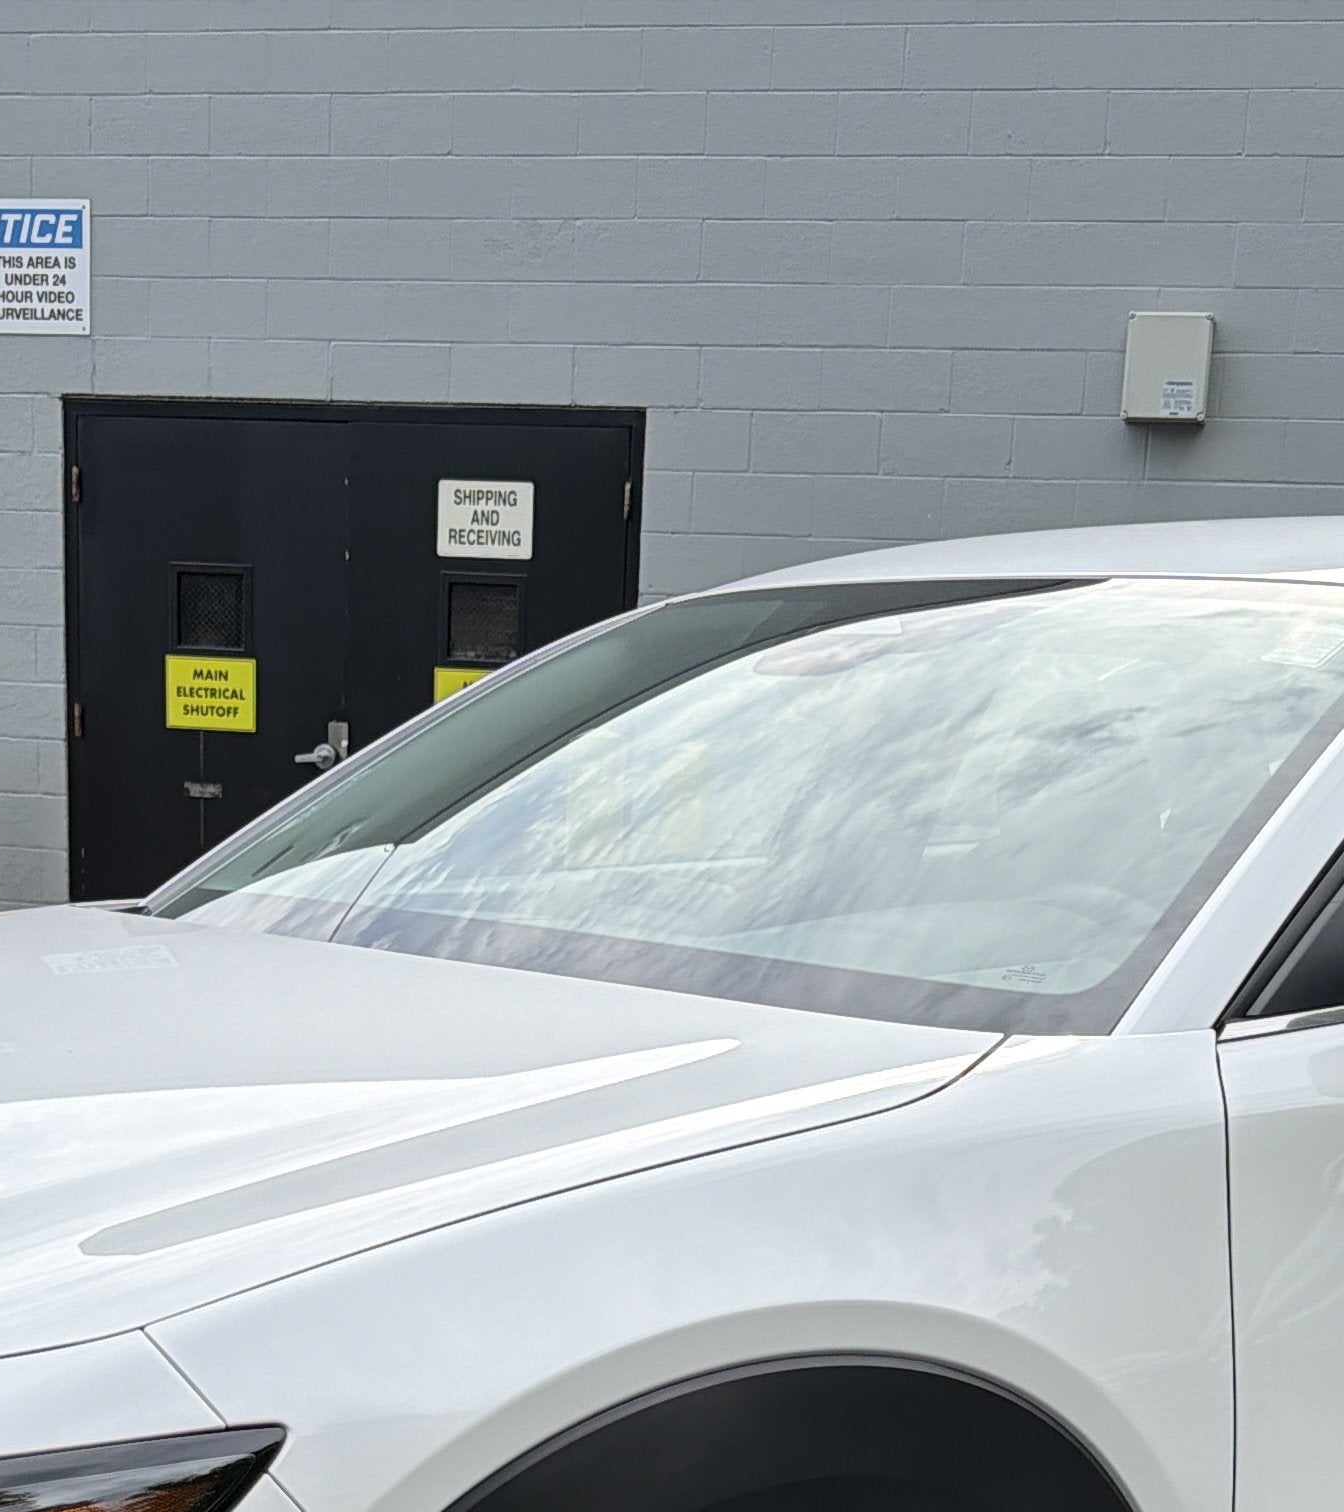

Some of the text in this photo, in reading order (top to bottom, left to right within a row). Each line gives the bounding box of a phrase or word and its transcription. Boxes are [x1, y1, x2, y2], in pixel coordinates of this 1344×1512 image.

[26, 256, 61, 269] AREA
[63, 256, 77, 270] IS
[4, 273, 67, 286] UNDER 24
[36, 291, 76, 304] VIDEO
[453, 488, 518, 507] SHIPPING
[470, 509, 500, 526] AND
[448, 528, 521, 547] RECEIVING
[193, 668, 229, 681] MAIN
[176, 686, 246, 700] ELECTRICAL
[183, 704, 240, 718] SHUTOFF
